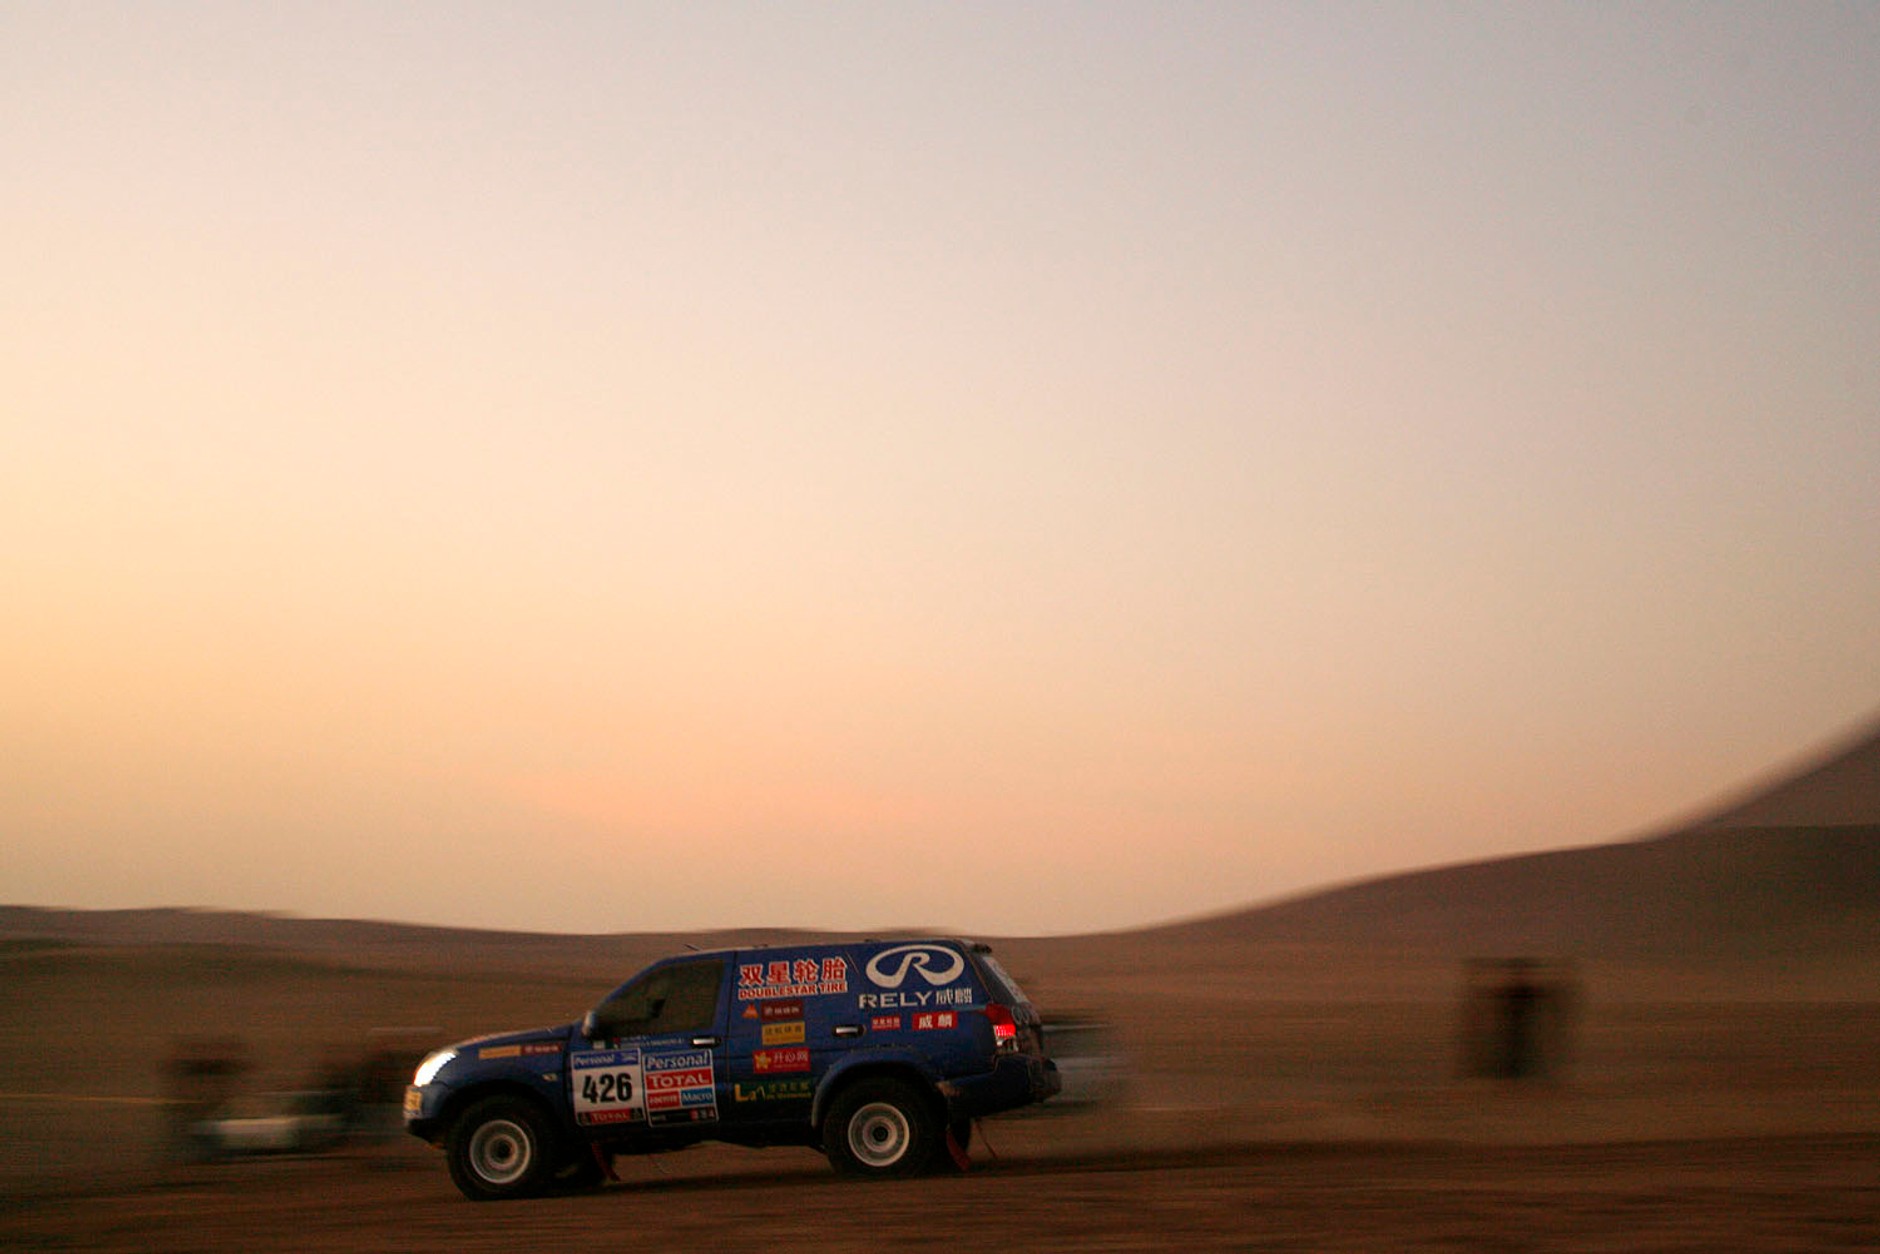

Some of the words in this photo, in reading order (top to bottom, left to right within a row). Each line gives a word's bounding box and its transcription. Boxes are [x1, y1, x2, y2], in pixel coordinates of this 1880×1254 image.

[738, 956, 848, 987] 双星轮胎
[738, 984, 818, 1000] DOUBLESTAR
[818, 981, 848, 995] TIRE
[859, 990, 933, 1009] RELY
[574, 1054, 616, 1067] Personal
[647, 1050, 709, 1070] Personal
[583, 1073, 633, 1103] 426
[650, 1073, 710, 1088] TOTAL
[681, 1091, 713, 1103] Macro
[591, 1111, 629, 1122] TOTAL
